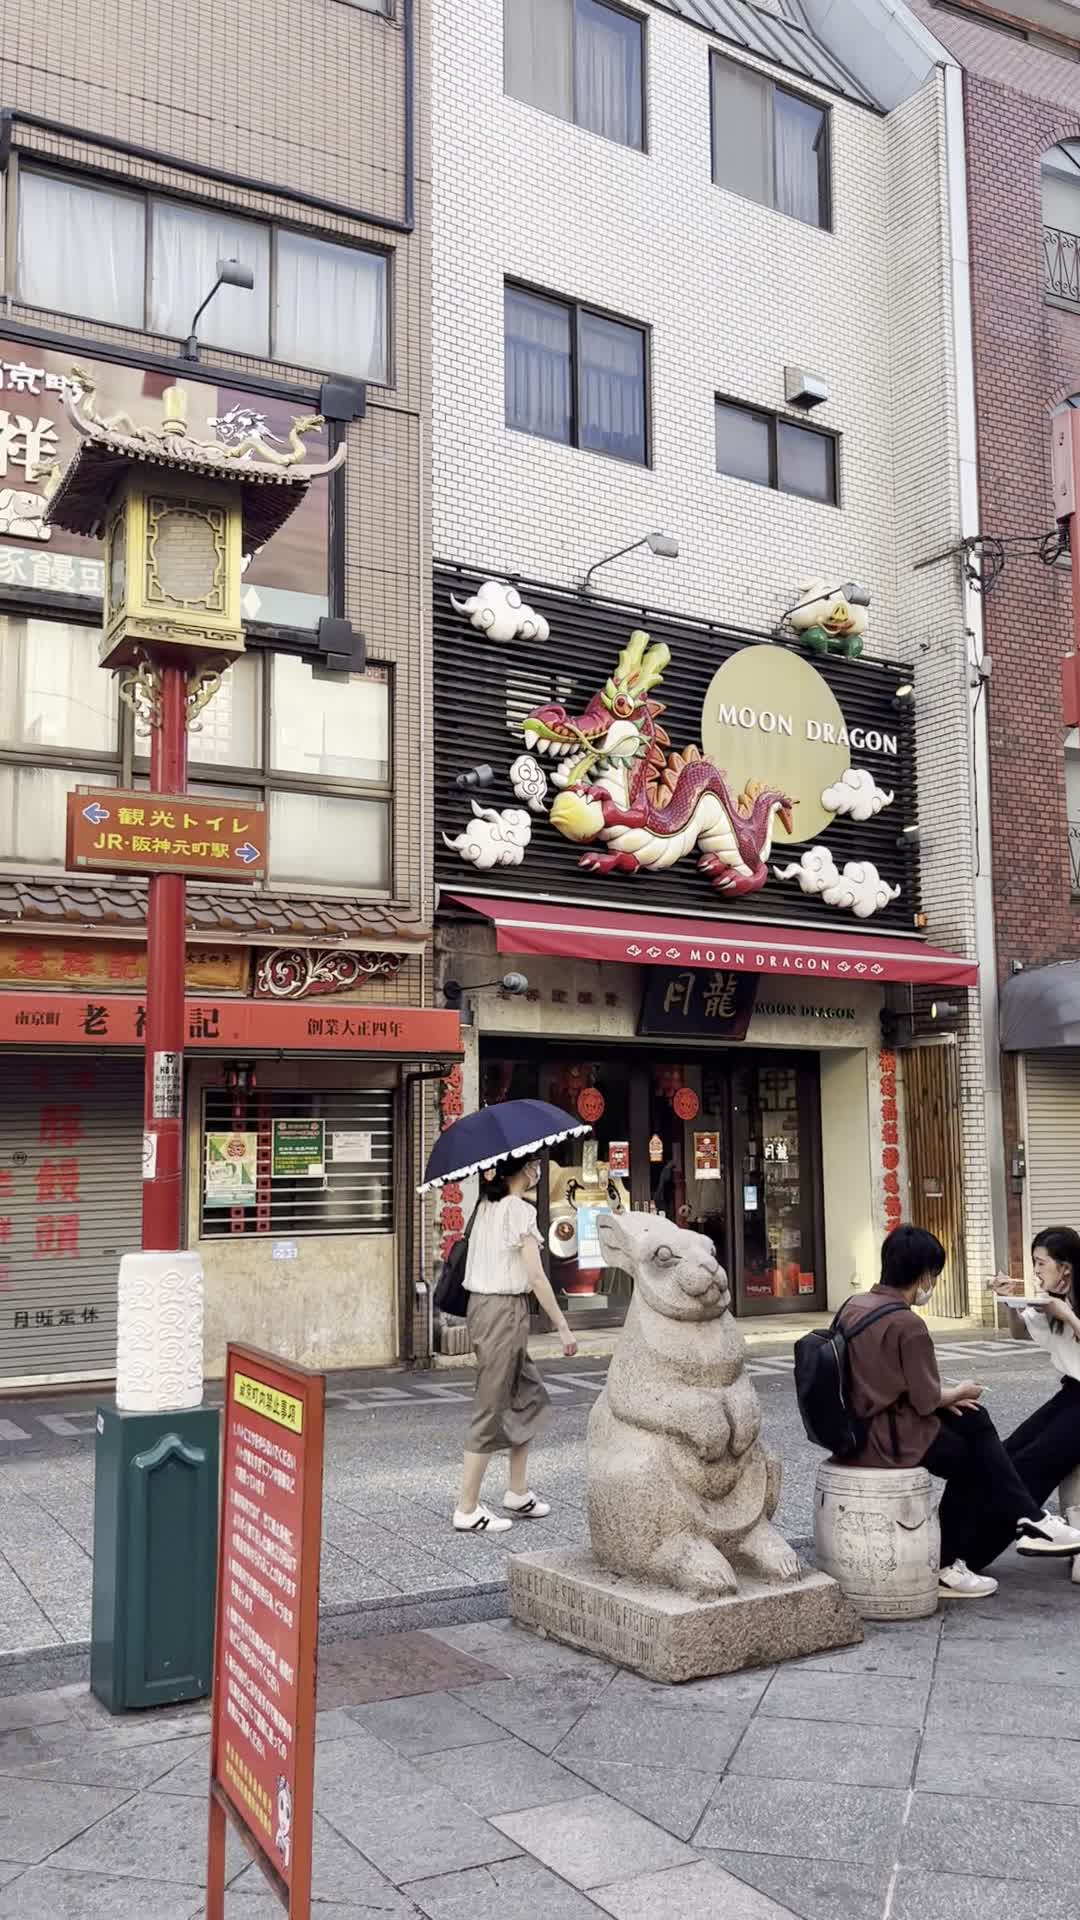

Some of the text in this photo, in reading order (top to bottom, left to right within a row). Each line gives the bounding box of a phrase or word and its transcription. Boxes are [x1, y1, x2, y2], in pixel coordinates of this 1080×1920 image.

[0, 360, 85, 404] 京町
[718, 704, 897, 754] MOON DRAGON
[117, 807, 249, 833] 観光トイレ
[690, 950, 830, 971] MOON DRAGON
[15, 1010, 60, 1026] 南京町
[307, 1018, 402, 1037] 創業大正四年
[754, 1003, 856, 1020] MOON DRAGON
[14, 1306, 99, 1329] 月曜定休
